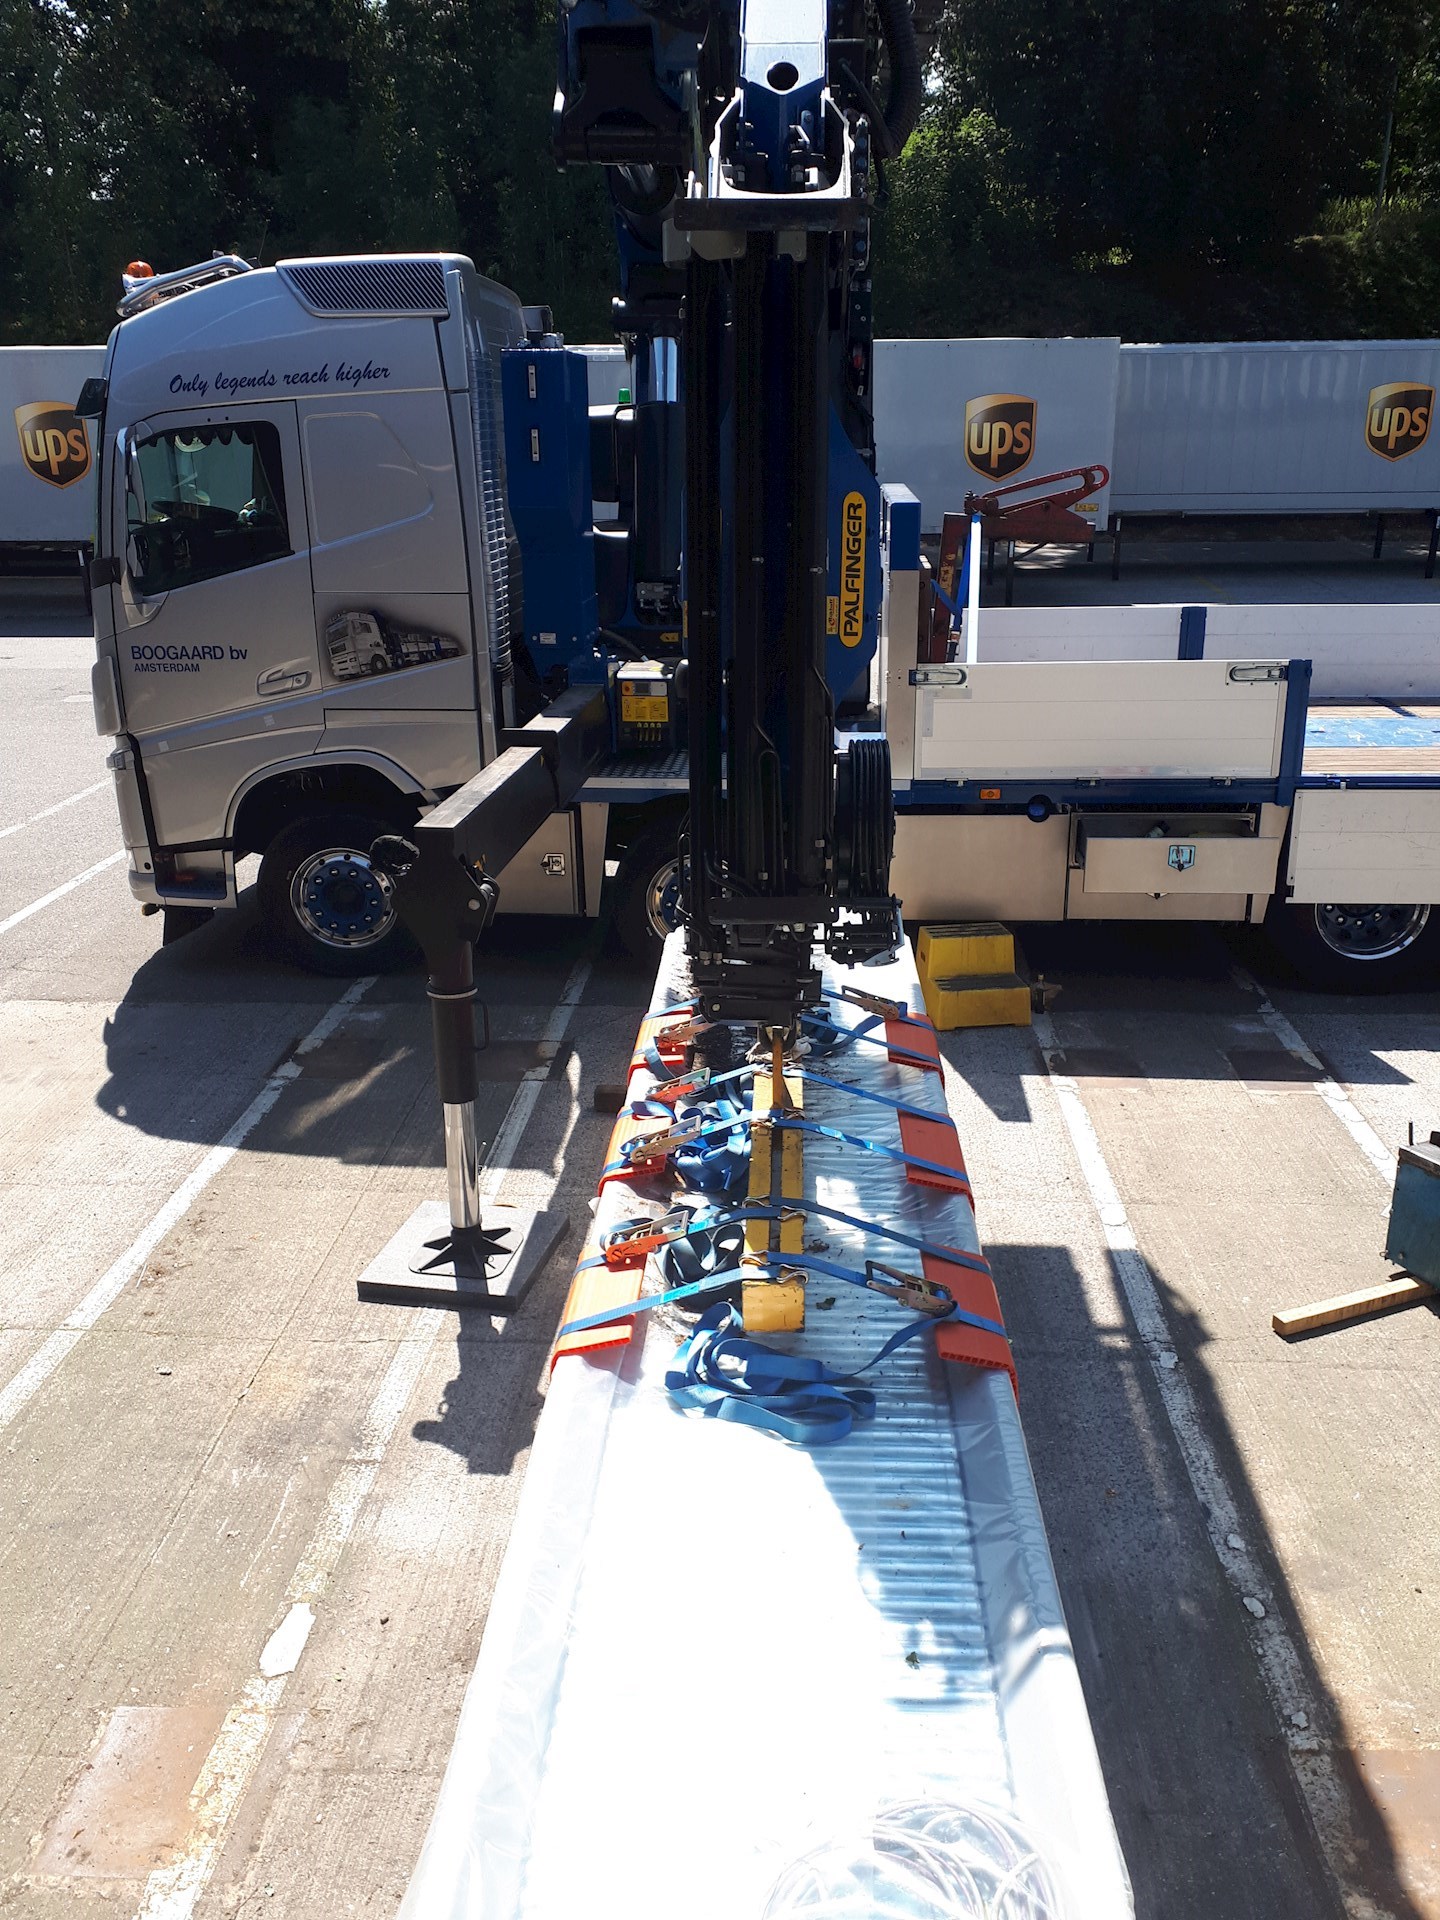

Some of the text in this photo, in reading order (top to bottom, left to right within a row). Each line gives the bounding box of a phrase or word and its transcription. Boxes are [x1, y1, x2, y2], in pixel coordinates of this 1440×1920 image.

[169, 360, 391, 397] Only legends reach higher
[969, 420, 1032, 468] ups
[1370, 406, 1429, 450] ups
[24, 428, 87, 476] ups
[843, 502, 863, 637] PALFINGER
[131, 645, 248, 660] BOOGAARD bv
[134, 663, 200, 673] AMSTERDAM
